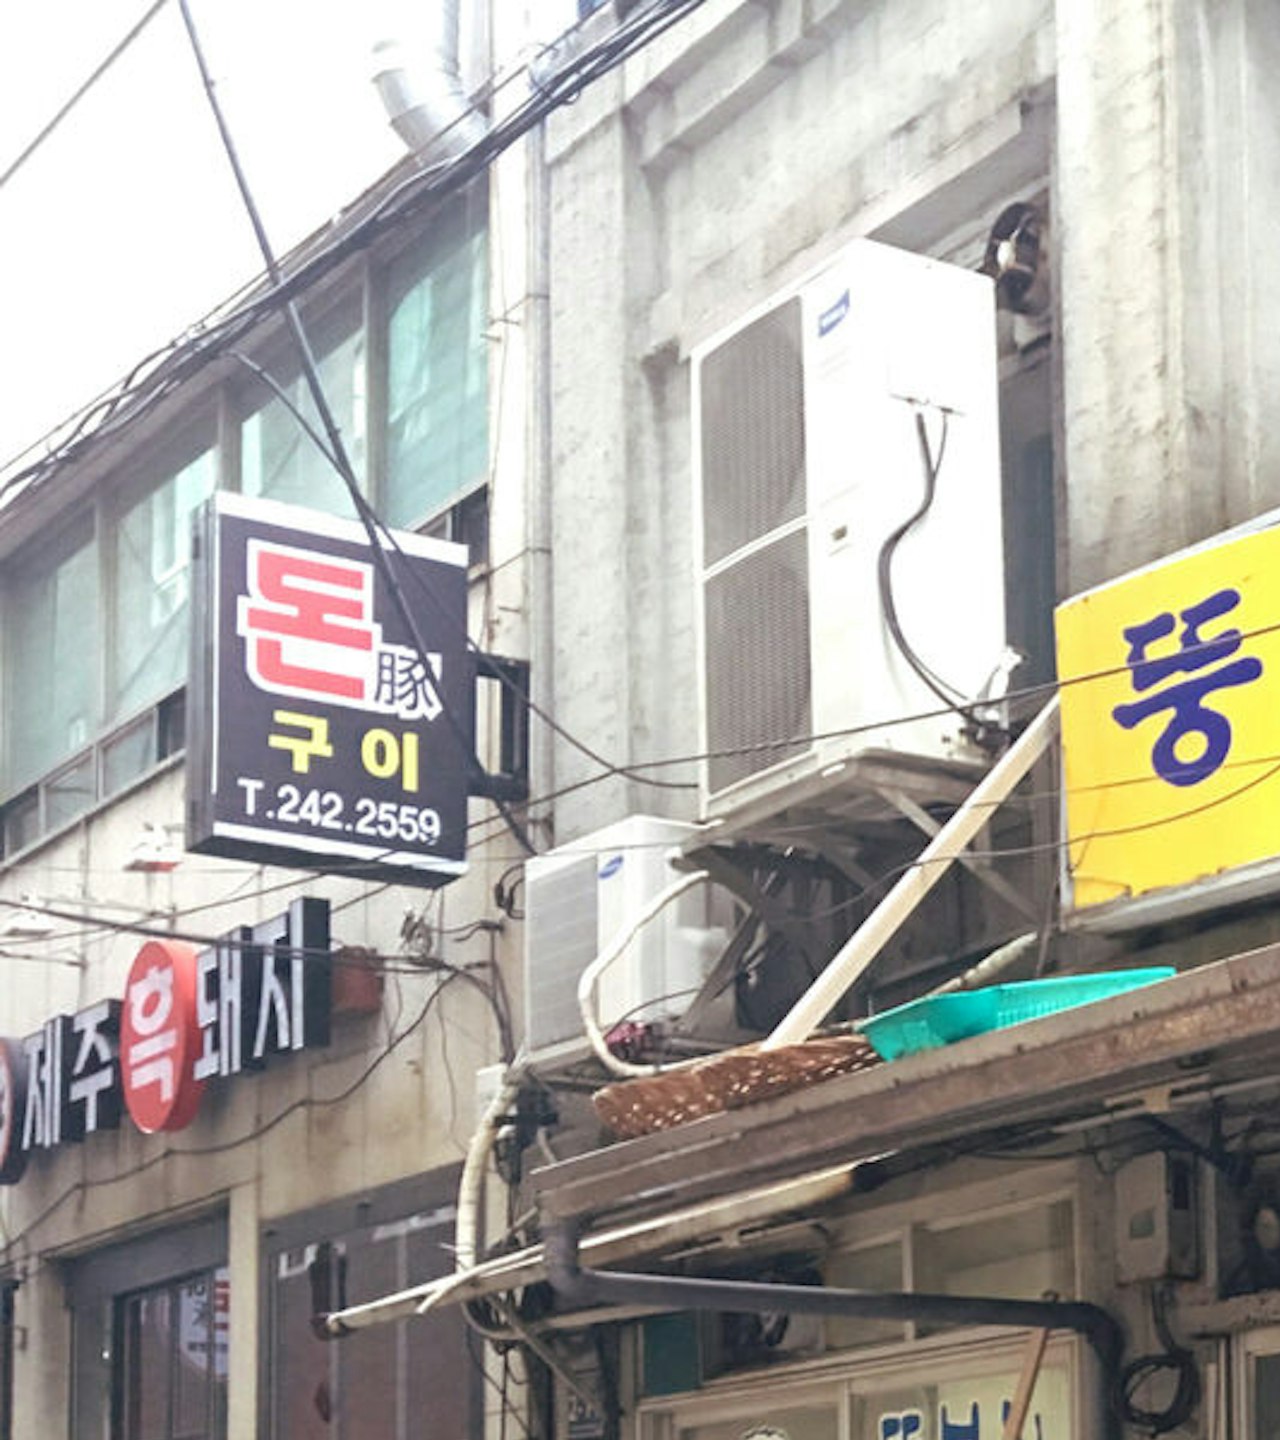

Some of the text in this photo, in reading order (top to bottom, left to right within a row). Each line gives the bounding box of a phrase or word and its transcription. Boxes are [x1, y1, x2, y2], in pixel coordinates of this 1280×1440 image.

[246, 549, 374, 701] 돈
[267, 709, 420, 793] 구이
[236, 777, 441, 846] T.242.2559
[22, 892, 304, 1150] 제주흑돼지
